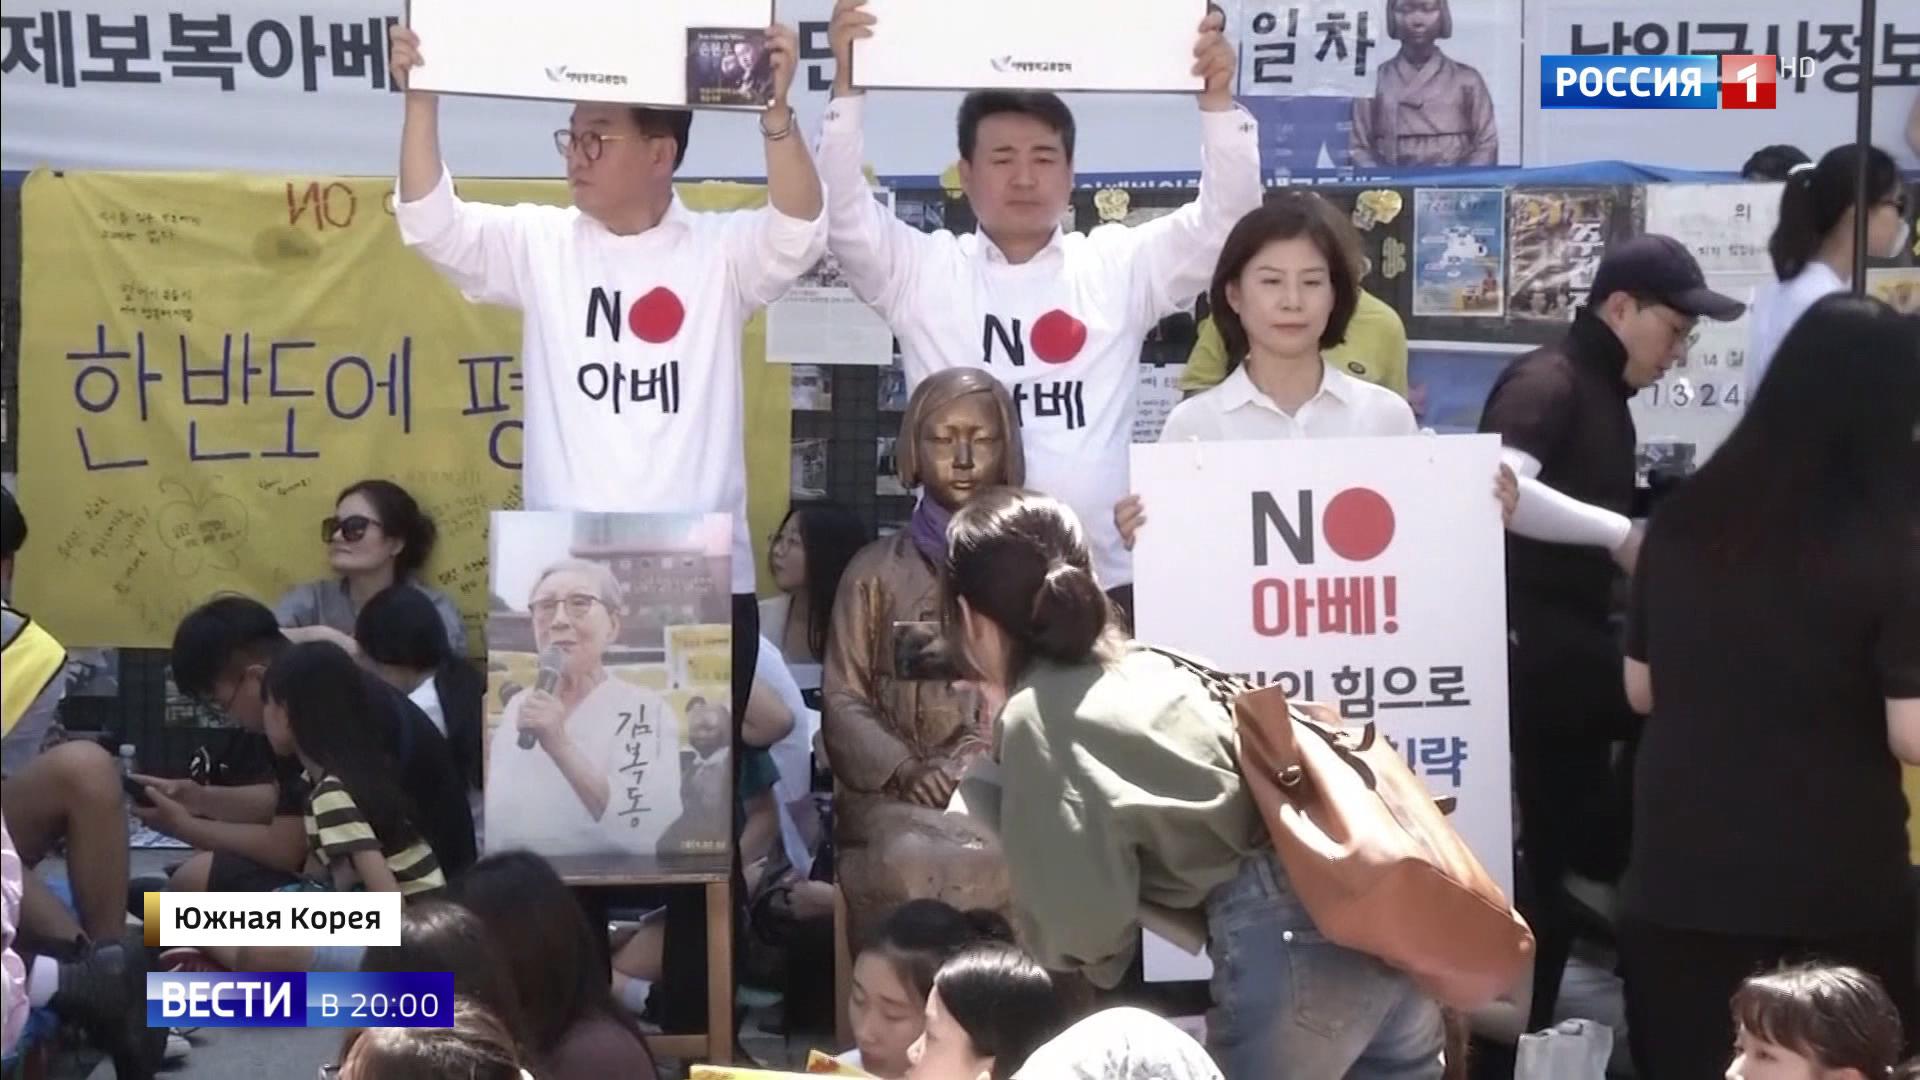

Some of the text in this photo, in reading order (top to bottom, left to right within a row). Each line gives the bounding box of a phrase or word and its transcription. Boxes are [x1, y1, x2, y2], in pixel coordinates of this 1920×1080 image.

[66, 324, 411, 470] 한반도에
[577, 360, 680, 414] 아베
[1252, 576, 1399, 638] 아베!
[1331, 665, 1471, 719] 힘으로
[615, 703, 653, 828] 김복동
